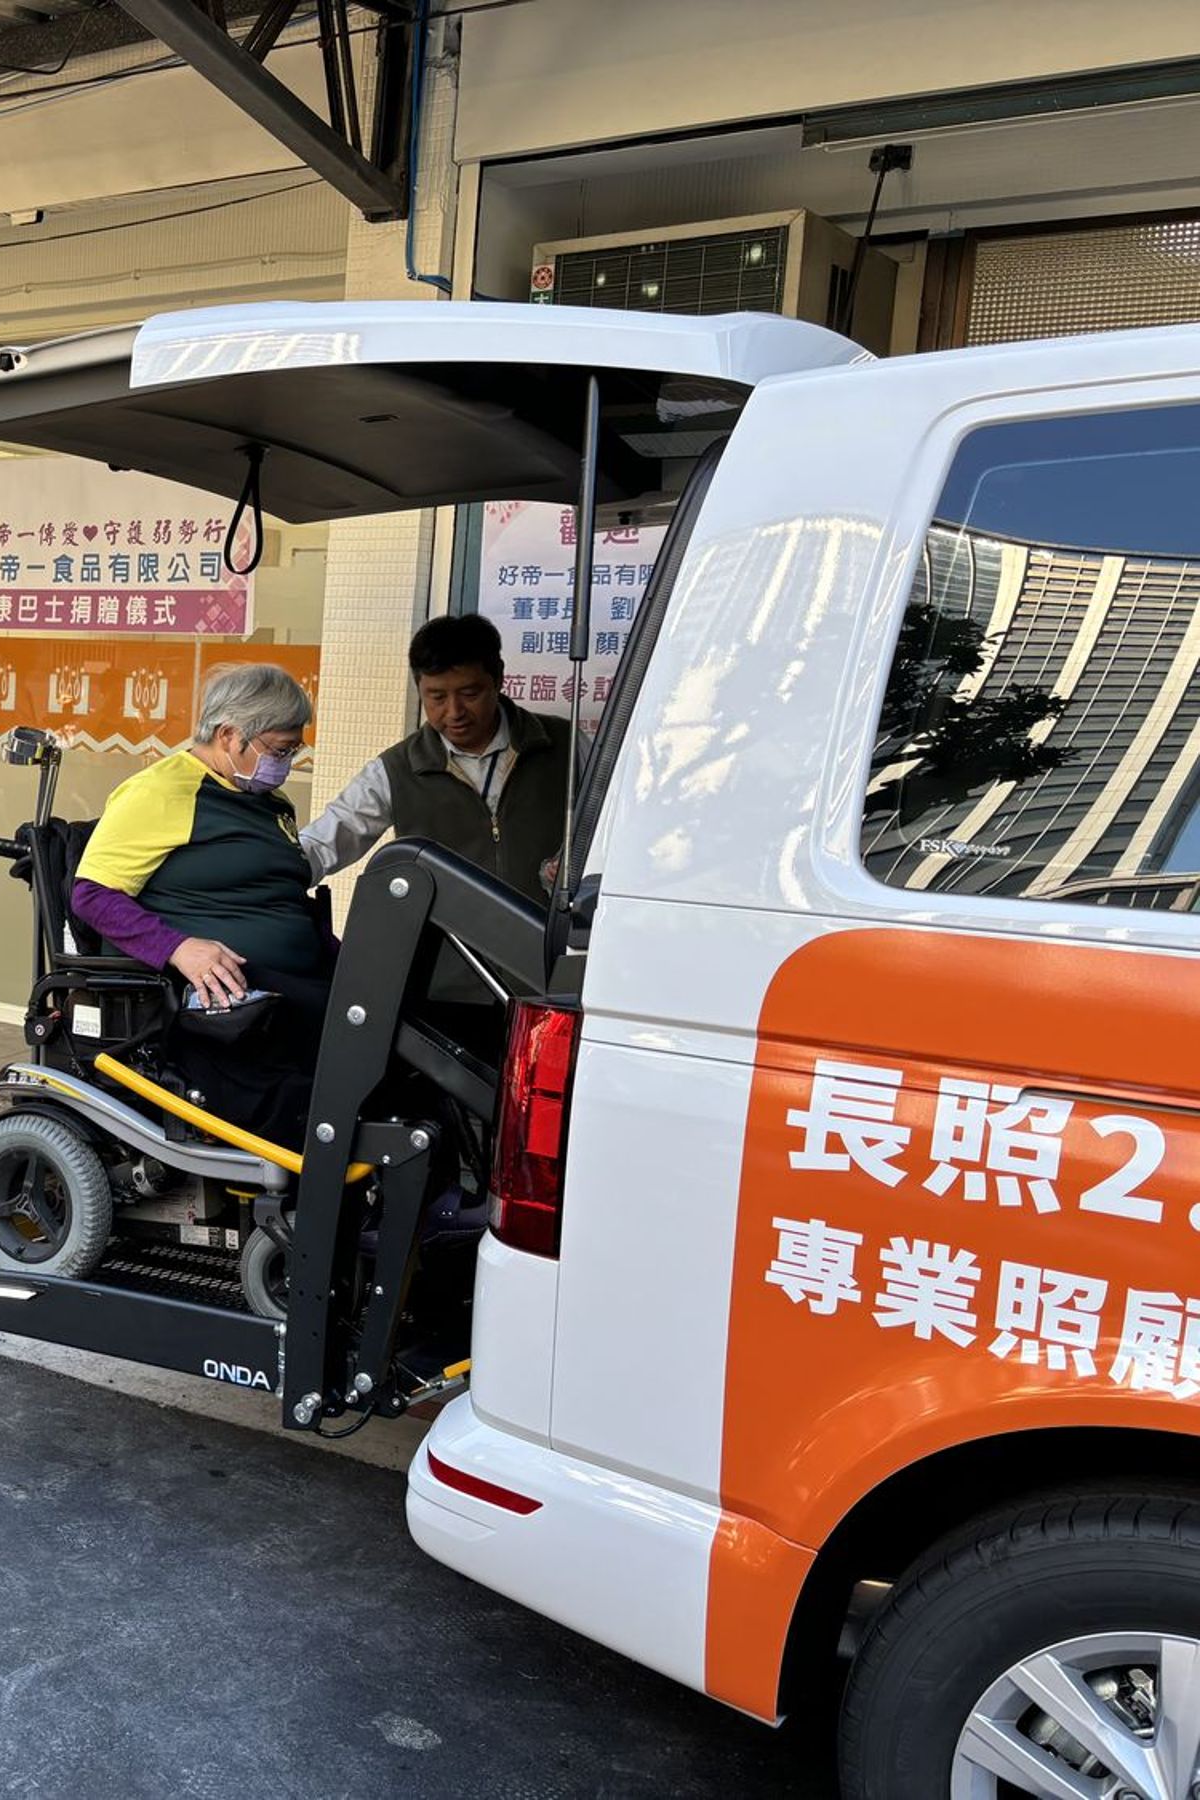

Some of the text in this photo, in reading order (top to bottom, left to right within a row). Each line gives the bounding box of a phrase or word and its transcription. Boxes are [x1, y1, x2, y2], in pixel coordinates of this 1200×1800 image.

[521, 630, 569, 655] 副理
[920, 839, 958, 859] FSK
[764, 1215, 1200, 1400] 專業照顧
[203, 1359, 271, 1391] ONDA
